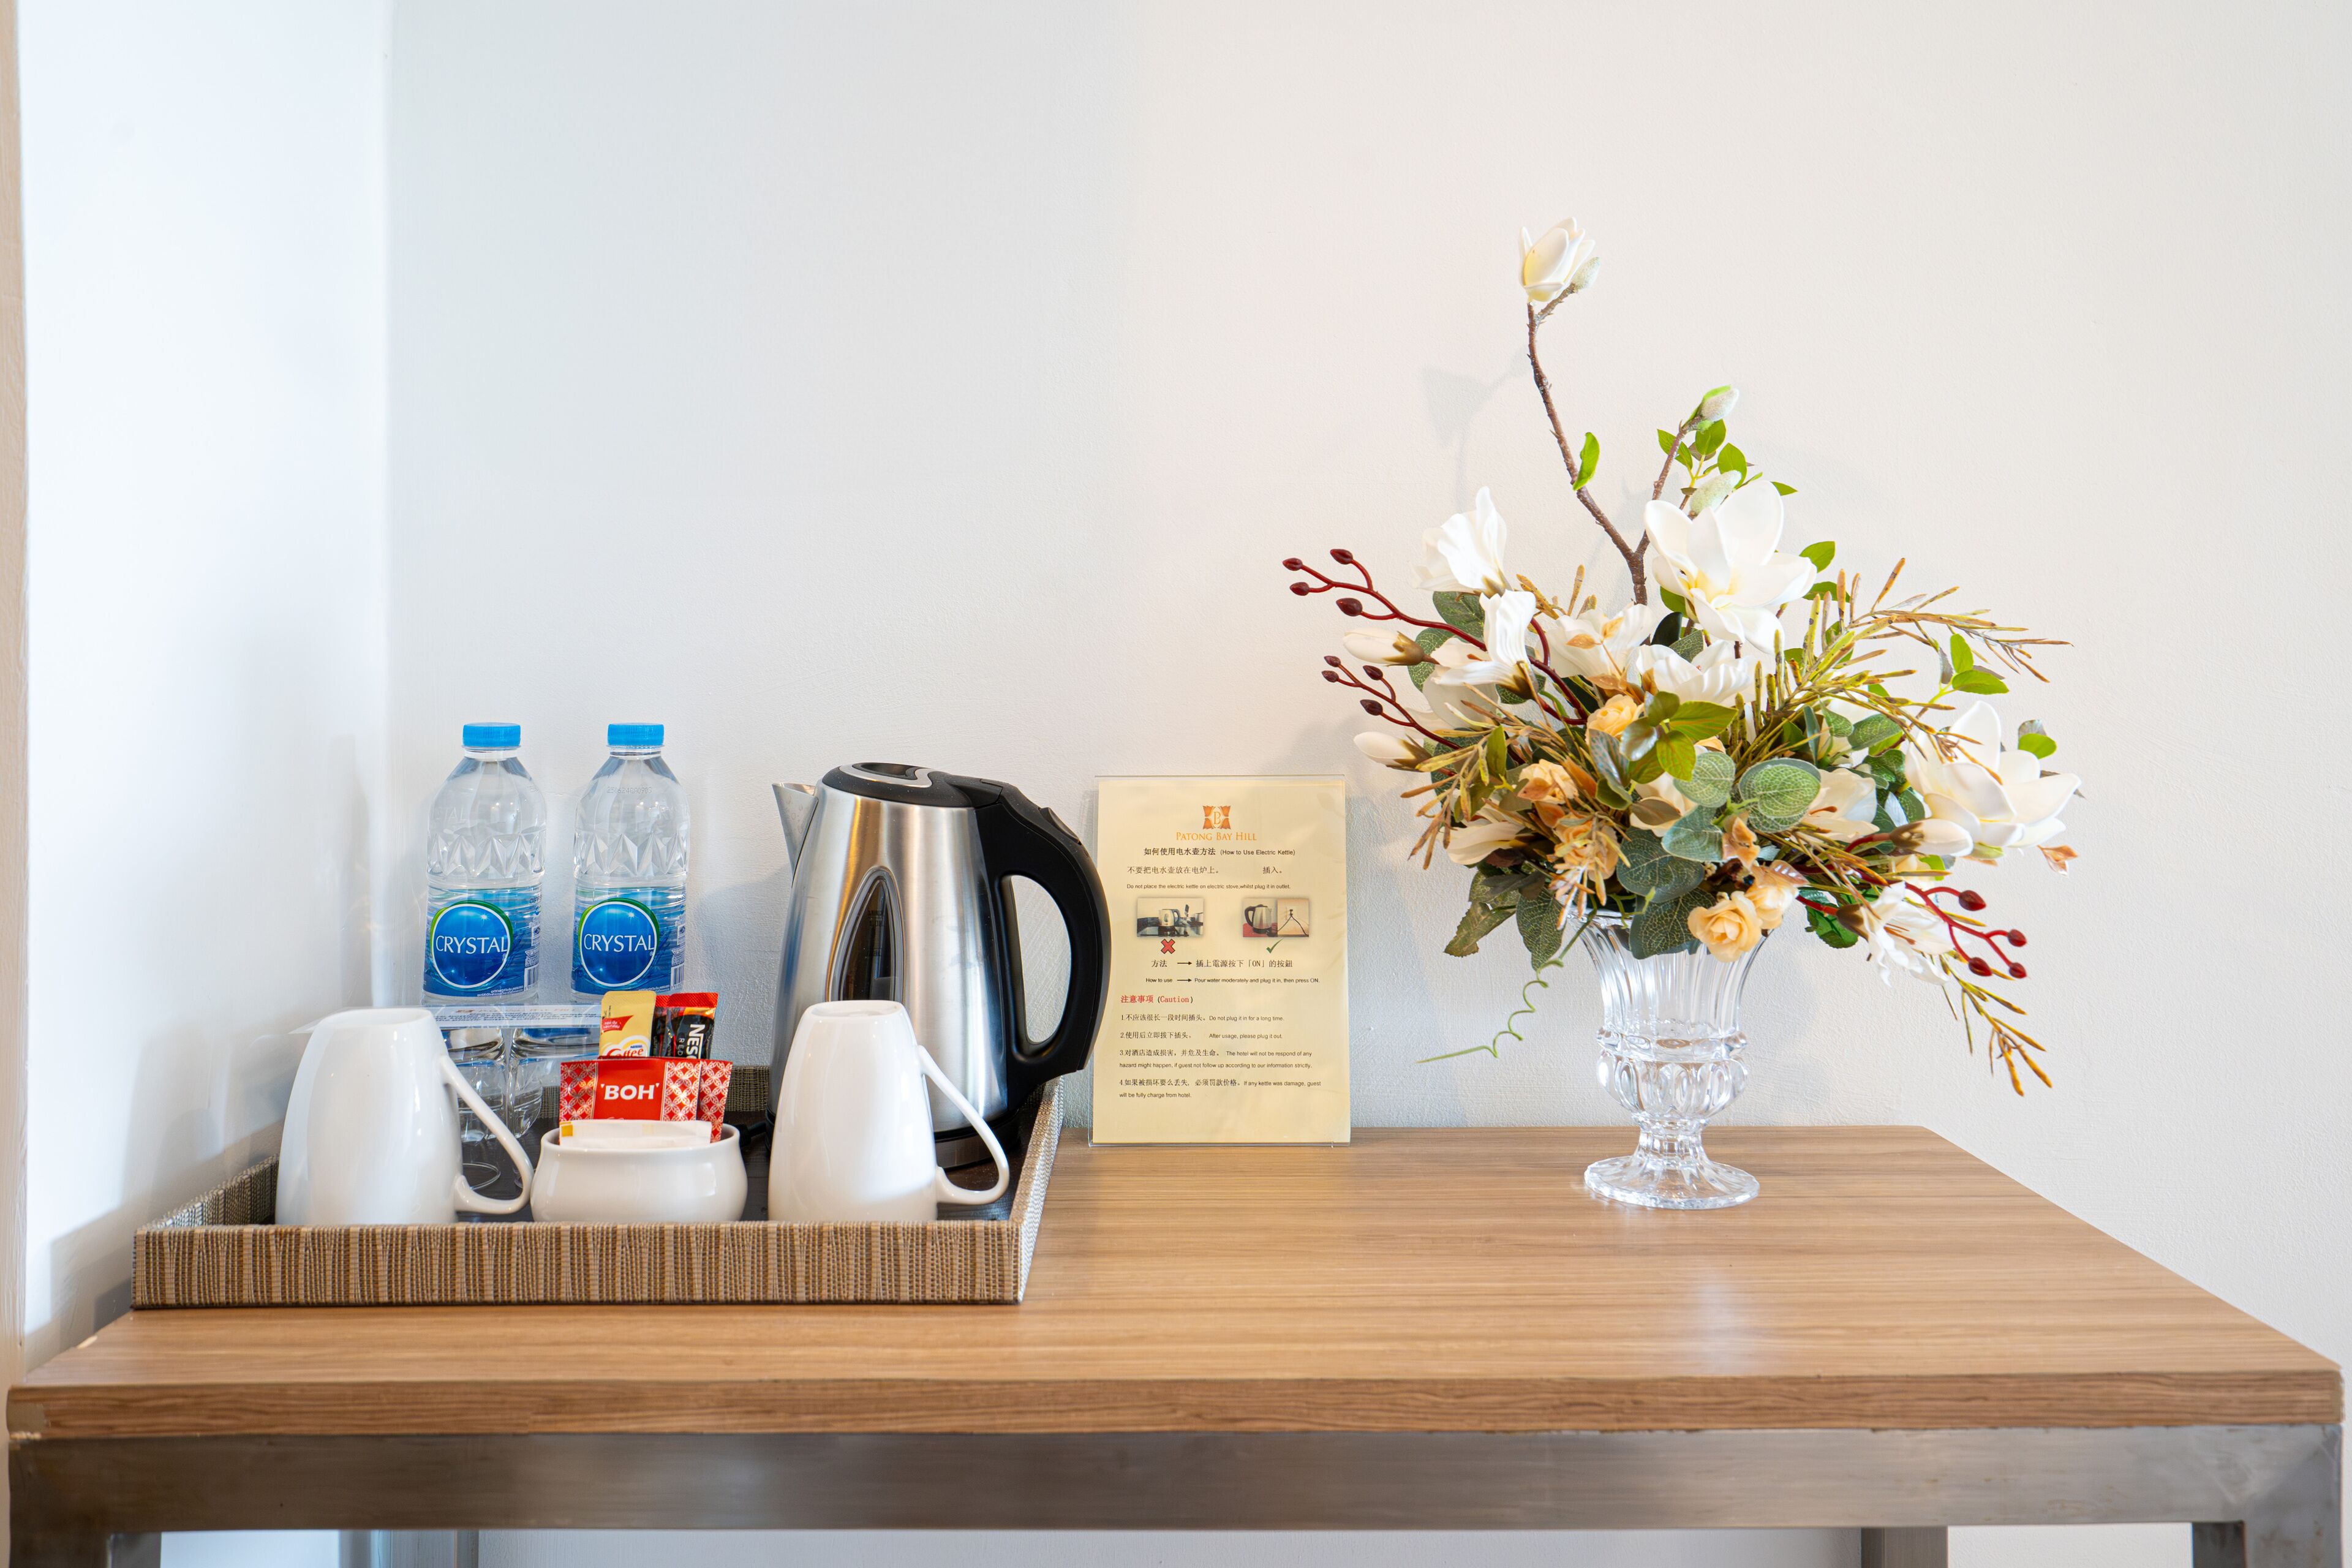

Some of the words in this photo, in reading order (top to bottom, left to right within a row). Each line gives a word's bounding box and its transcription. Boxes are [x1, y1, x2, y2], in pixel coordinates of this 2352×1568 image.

[1213, 812, 1221, 824] B
[435, 935, 508, 954] CRYSTAL
[584, 933, 655, 952] CRYSTAL
[1120, 995, 1153, 1003] 注意事项
[686, 1024, 705, 1058] NES
